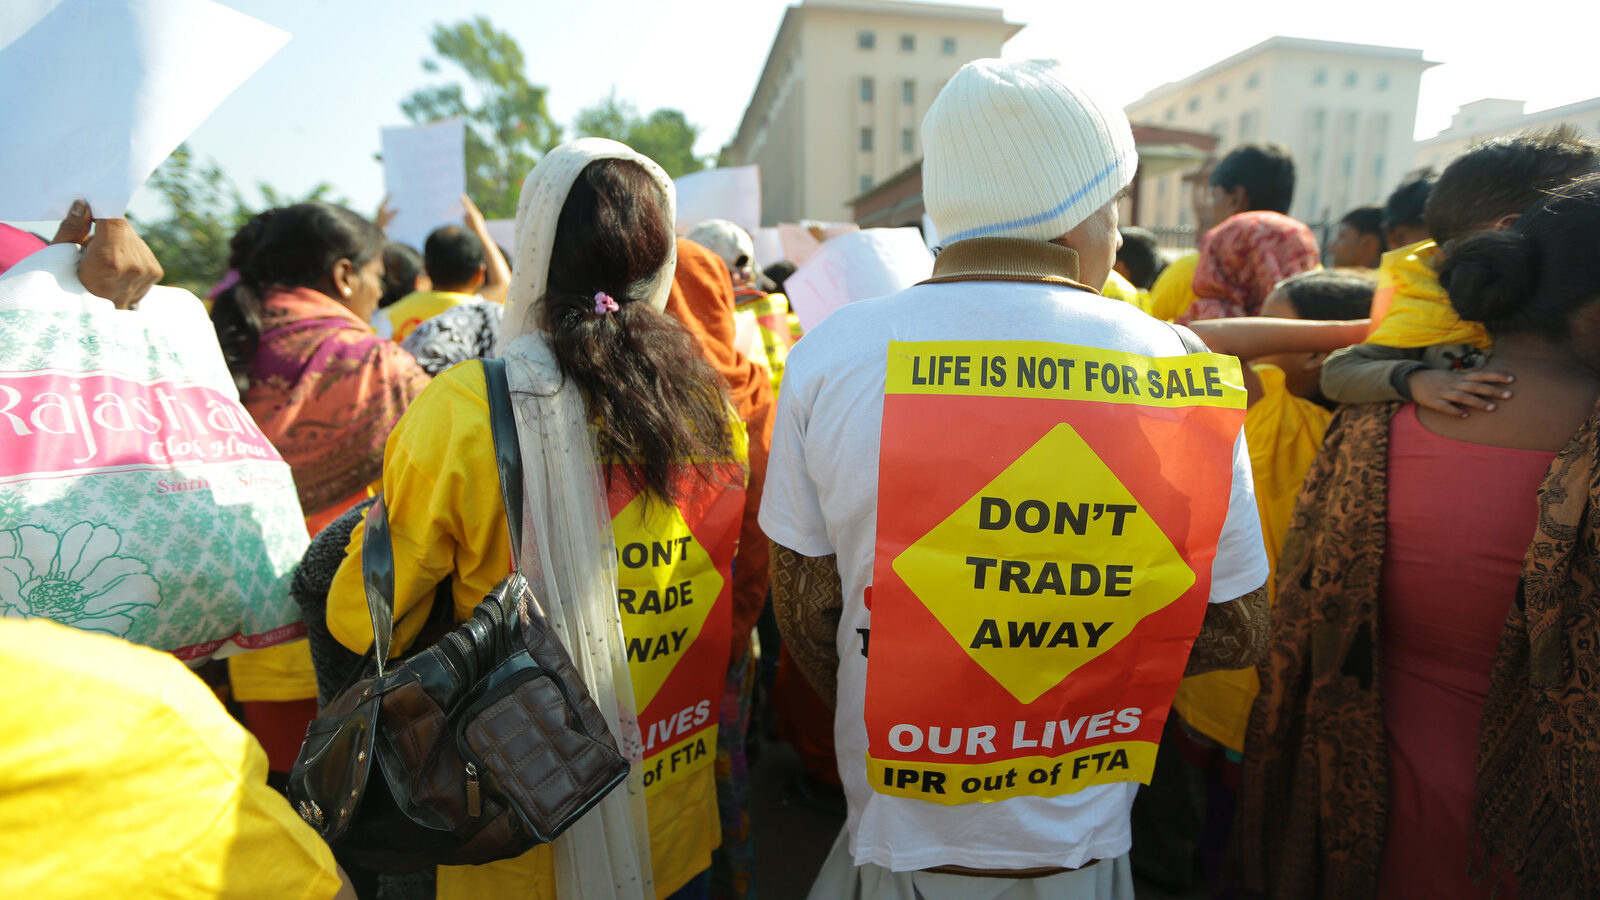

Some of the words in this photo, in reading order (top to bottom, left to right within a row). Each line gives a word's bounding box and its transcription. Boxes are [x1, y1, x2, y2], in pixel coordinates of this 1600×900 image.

[912, 355, 970, 385] LIFE
[980, 356, 1006, 387] IS
[1017, 357, 1075, 391] NOT
[1085, 361, 1140, 396] FOR
[1147, 366, 1223, 399] SALE
[978, 497, 1137, 537] DON'T
[618, 580, 693, 614] RADE
[965, 557, 1134, 597] TRADE
[624, 627, 689, 663] WAY
[969, 619, 1114, 649] AWAY
[888, 723, 996, 756] OUR
[1012, 706, 1142, 750] LIVES
[643, 758, 664, 787] of
[670, 738, 707, 774] FTA
[883, 765, 947, 795] IPR
[961, 767, 1017, 794] out
[1028, 760, 1063, 786] of
[1072, 748, 1130, 780] FTA
